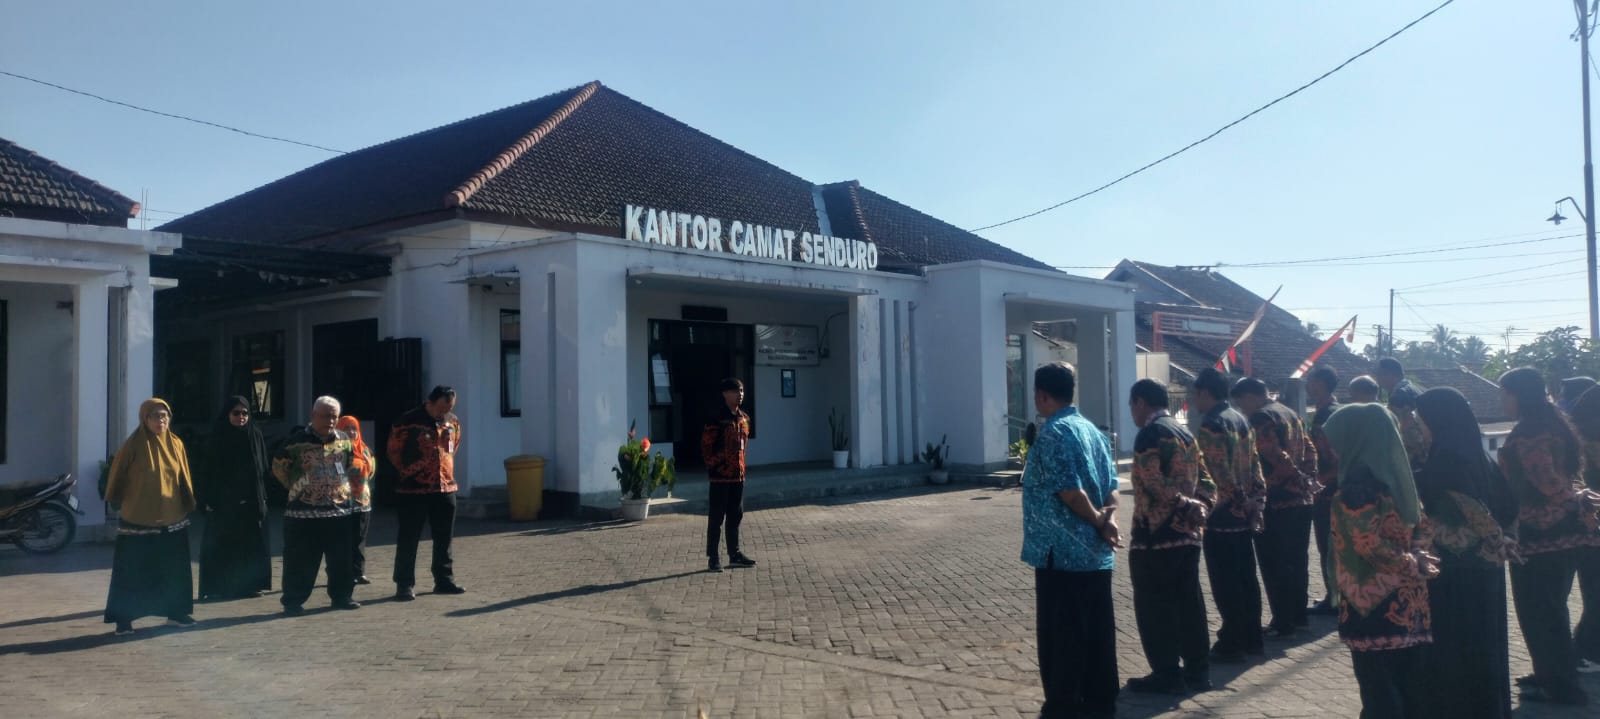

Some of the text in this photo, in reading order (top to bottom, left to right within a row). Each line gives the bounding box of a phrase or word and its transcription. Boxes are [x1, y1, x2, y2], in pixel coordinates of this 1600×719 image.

[625, 204, 878, 270] KANTOR CAMAT SENDURO
